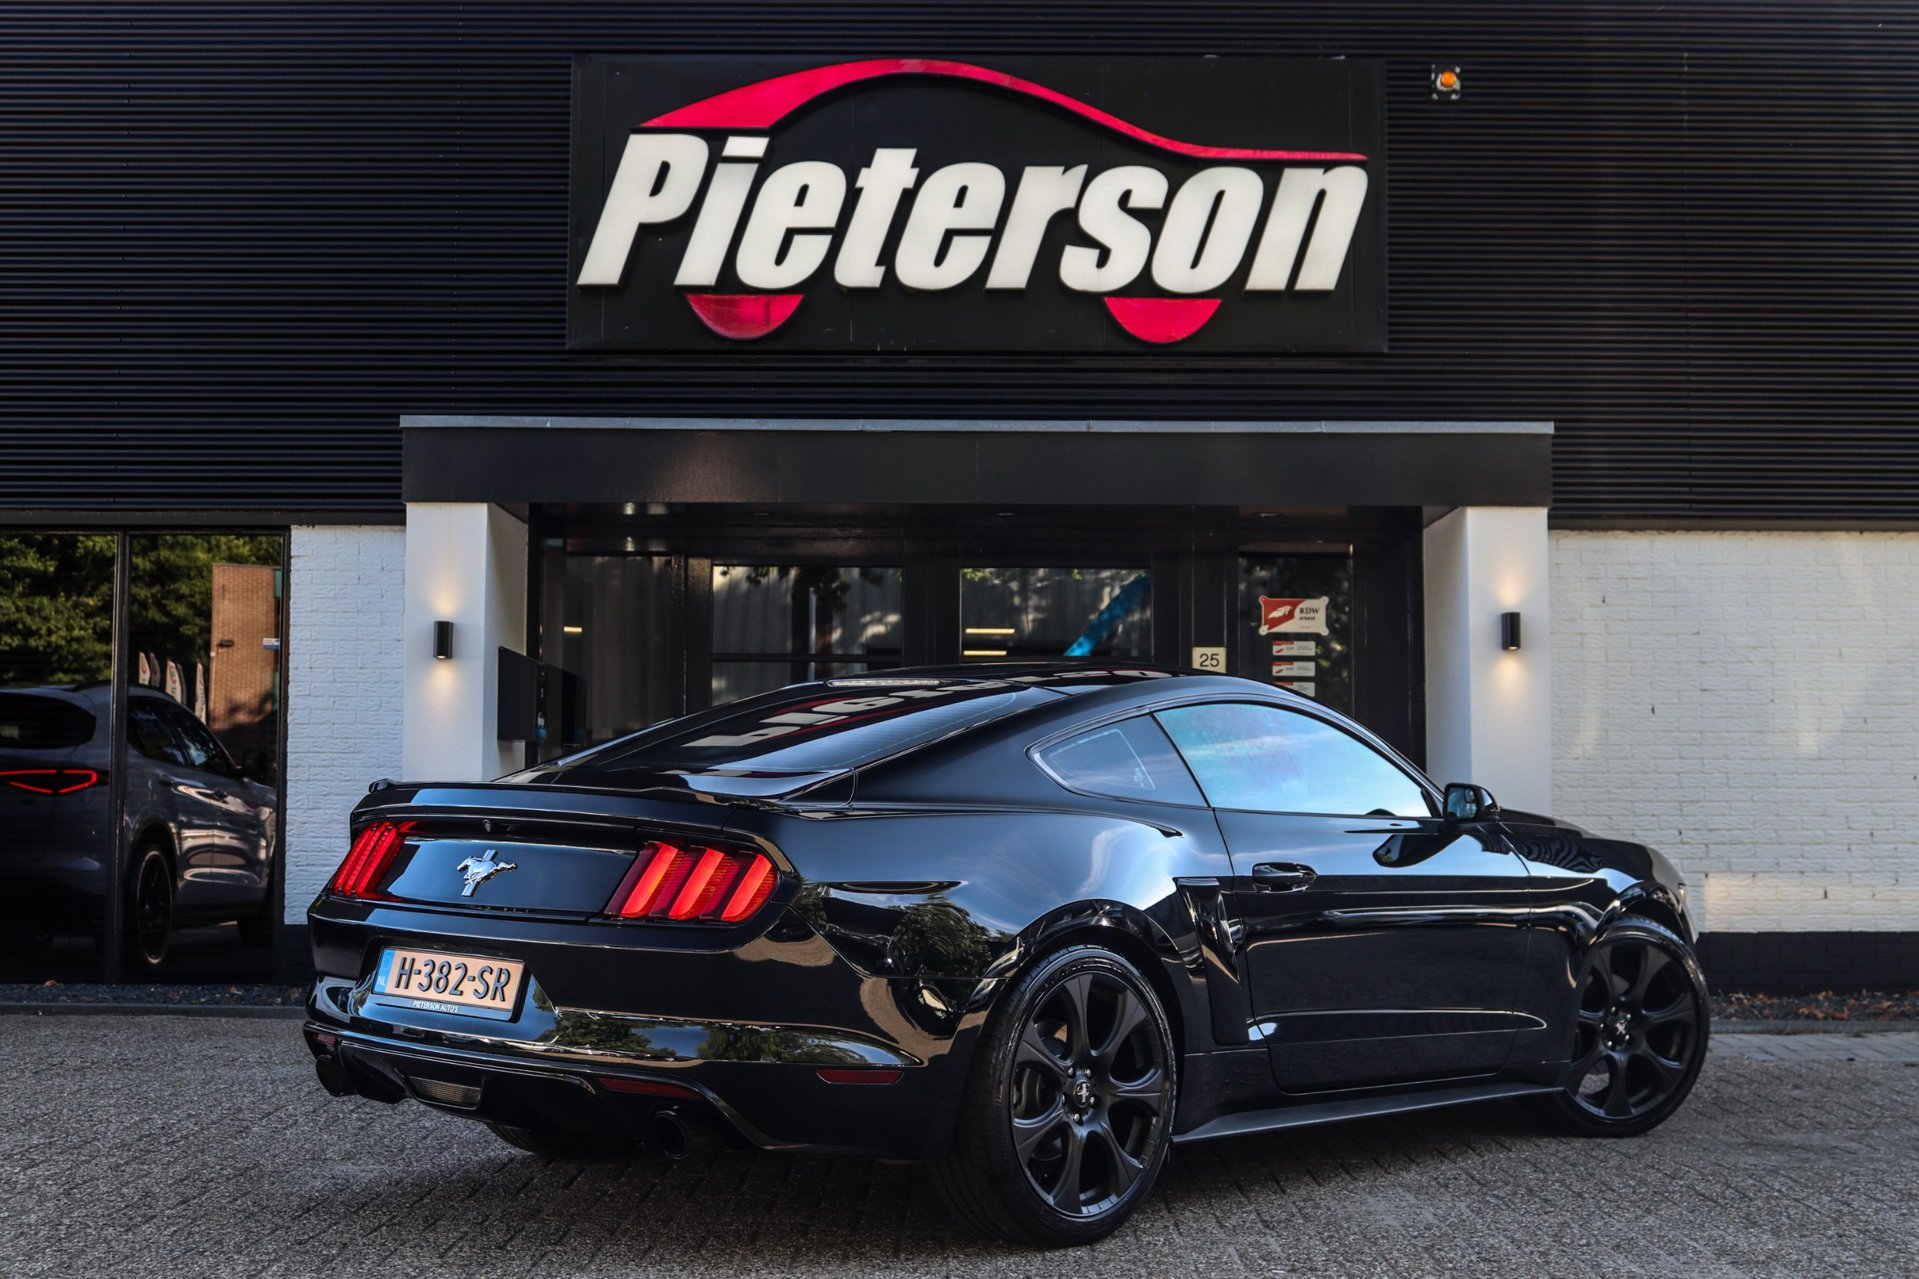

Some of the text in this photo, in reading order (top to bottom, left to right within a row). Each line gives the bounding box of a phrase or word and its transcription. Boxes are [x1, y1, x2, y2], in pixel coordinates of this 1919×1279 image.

[576, 132, 1369, 295] Pieterson
[1199, 652, 1220, 668] 25
[378, 976, 386, 986] NL
[394, 956, 511, 1002] H-382-SR
[412, 1000, 441, 1010] PIETERSON
